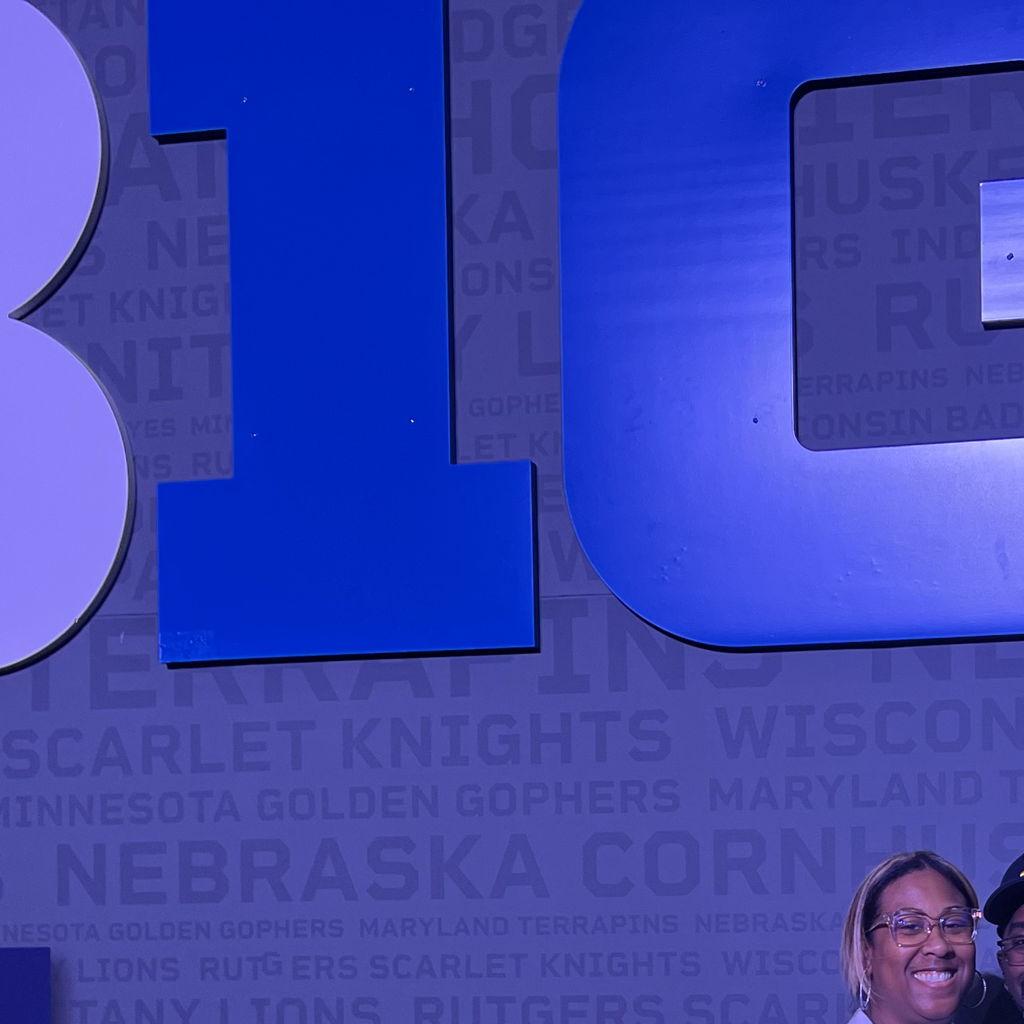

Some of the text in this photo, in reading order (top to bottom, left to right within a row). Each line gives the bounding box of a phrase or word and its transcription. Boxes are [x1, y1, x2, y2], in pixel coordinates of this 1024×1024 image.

[2, 717, 317, 779] SCARLET
[342, 708, 672, 769] KNIGHTS
[257, 784, 440, 822] GOLDEN
[456, 778, 681, 817] GOPHERS
[709, 768, 983, 812] MARYLAND
[56, 832, 551, 906] NEBRASKA
[109, 920, 211, 942] GOLDEN
[220, 918, 344, 940] GOPHERS
[360, 915, 509, 938] MARYLAND
[518, 913, 679, 936] TERRAPINS
[77, 956, 181, 984] LIONS
[370, 952, 529, 980] SCARLET
[541, 950, 701, 978] KNIGHTS
